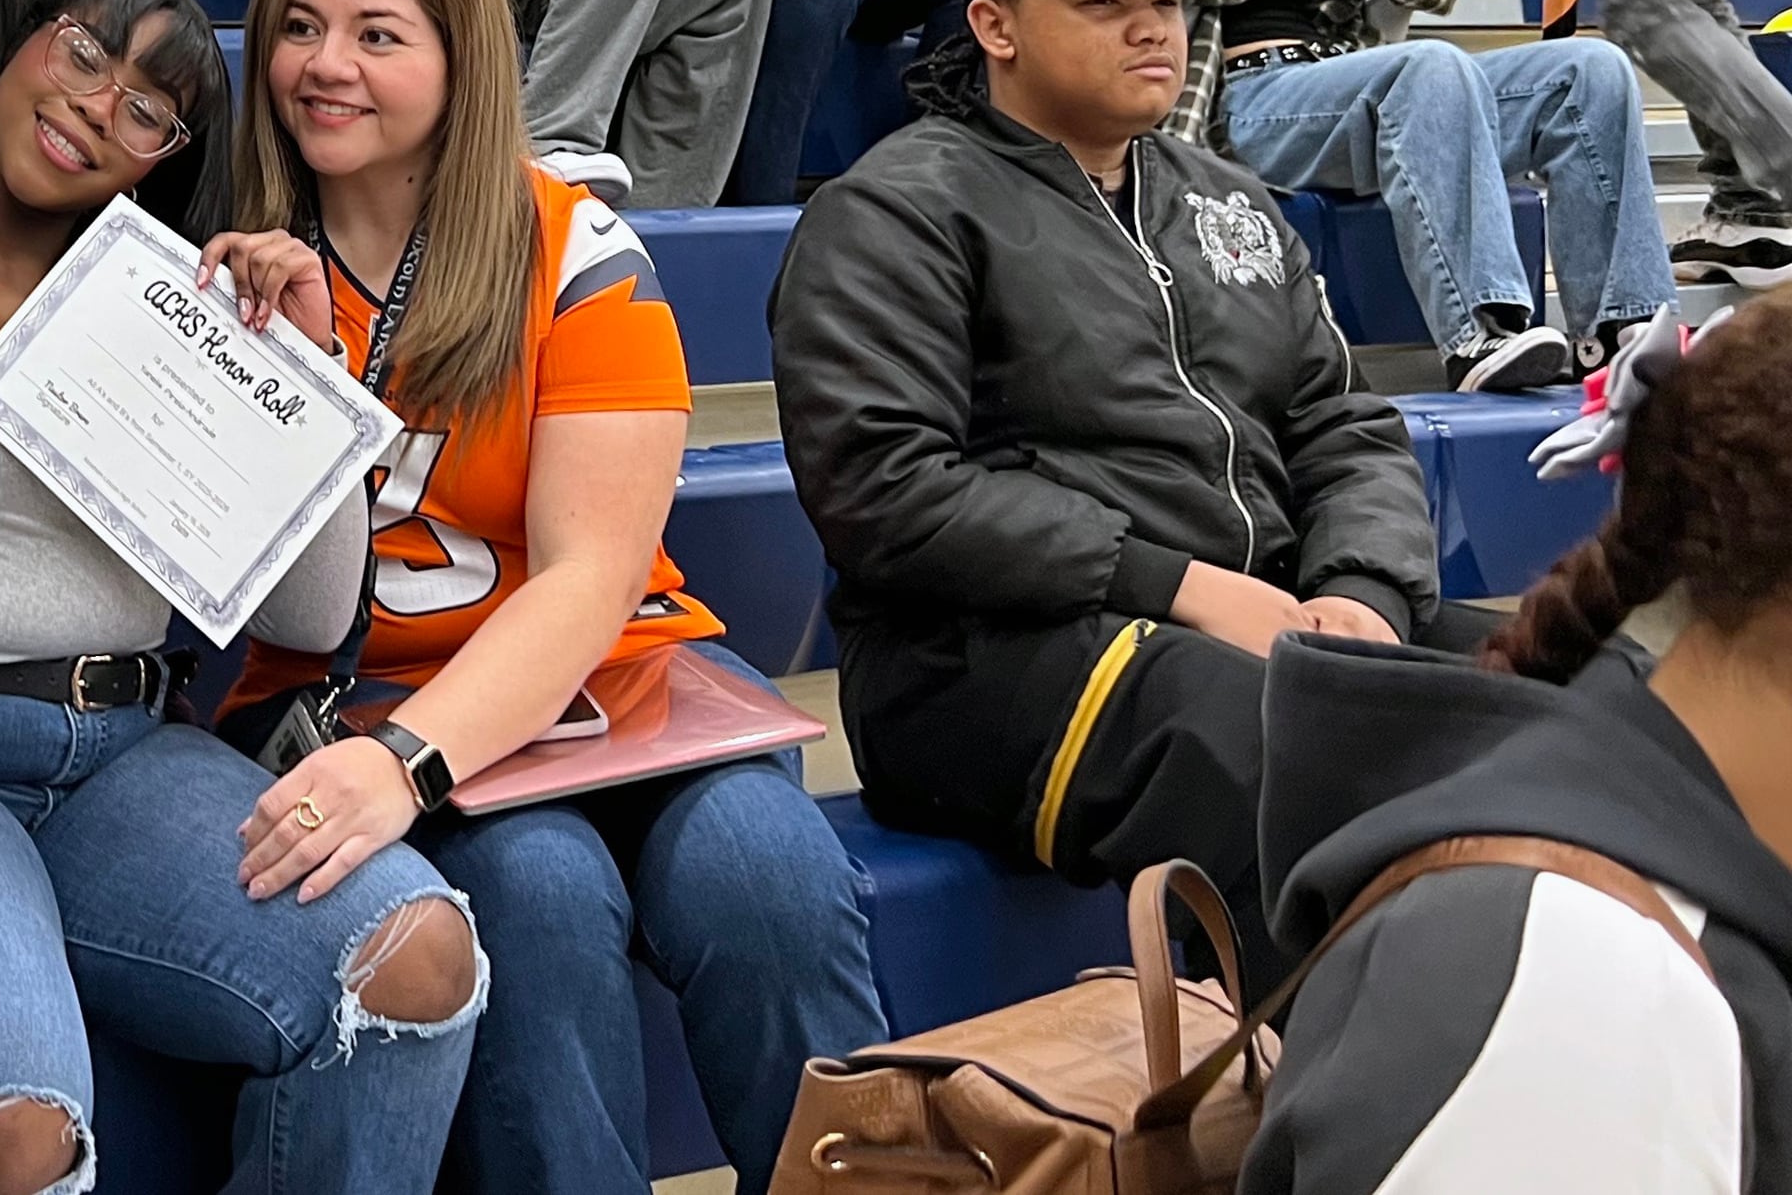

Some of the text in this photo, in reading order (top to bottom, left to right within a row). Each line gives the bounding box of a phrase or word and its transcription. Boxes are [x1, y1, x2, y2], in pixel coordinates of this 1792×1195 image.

[161, 365, 205, 406] presented
[205, 404, 214, 414] to
[199, 327, 253, 385] Honor
[254, 379, 305, 424] Roll
[152, 413, 164, 426] for
